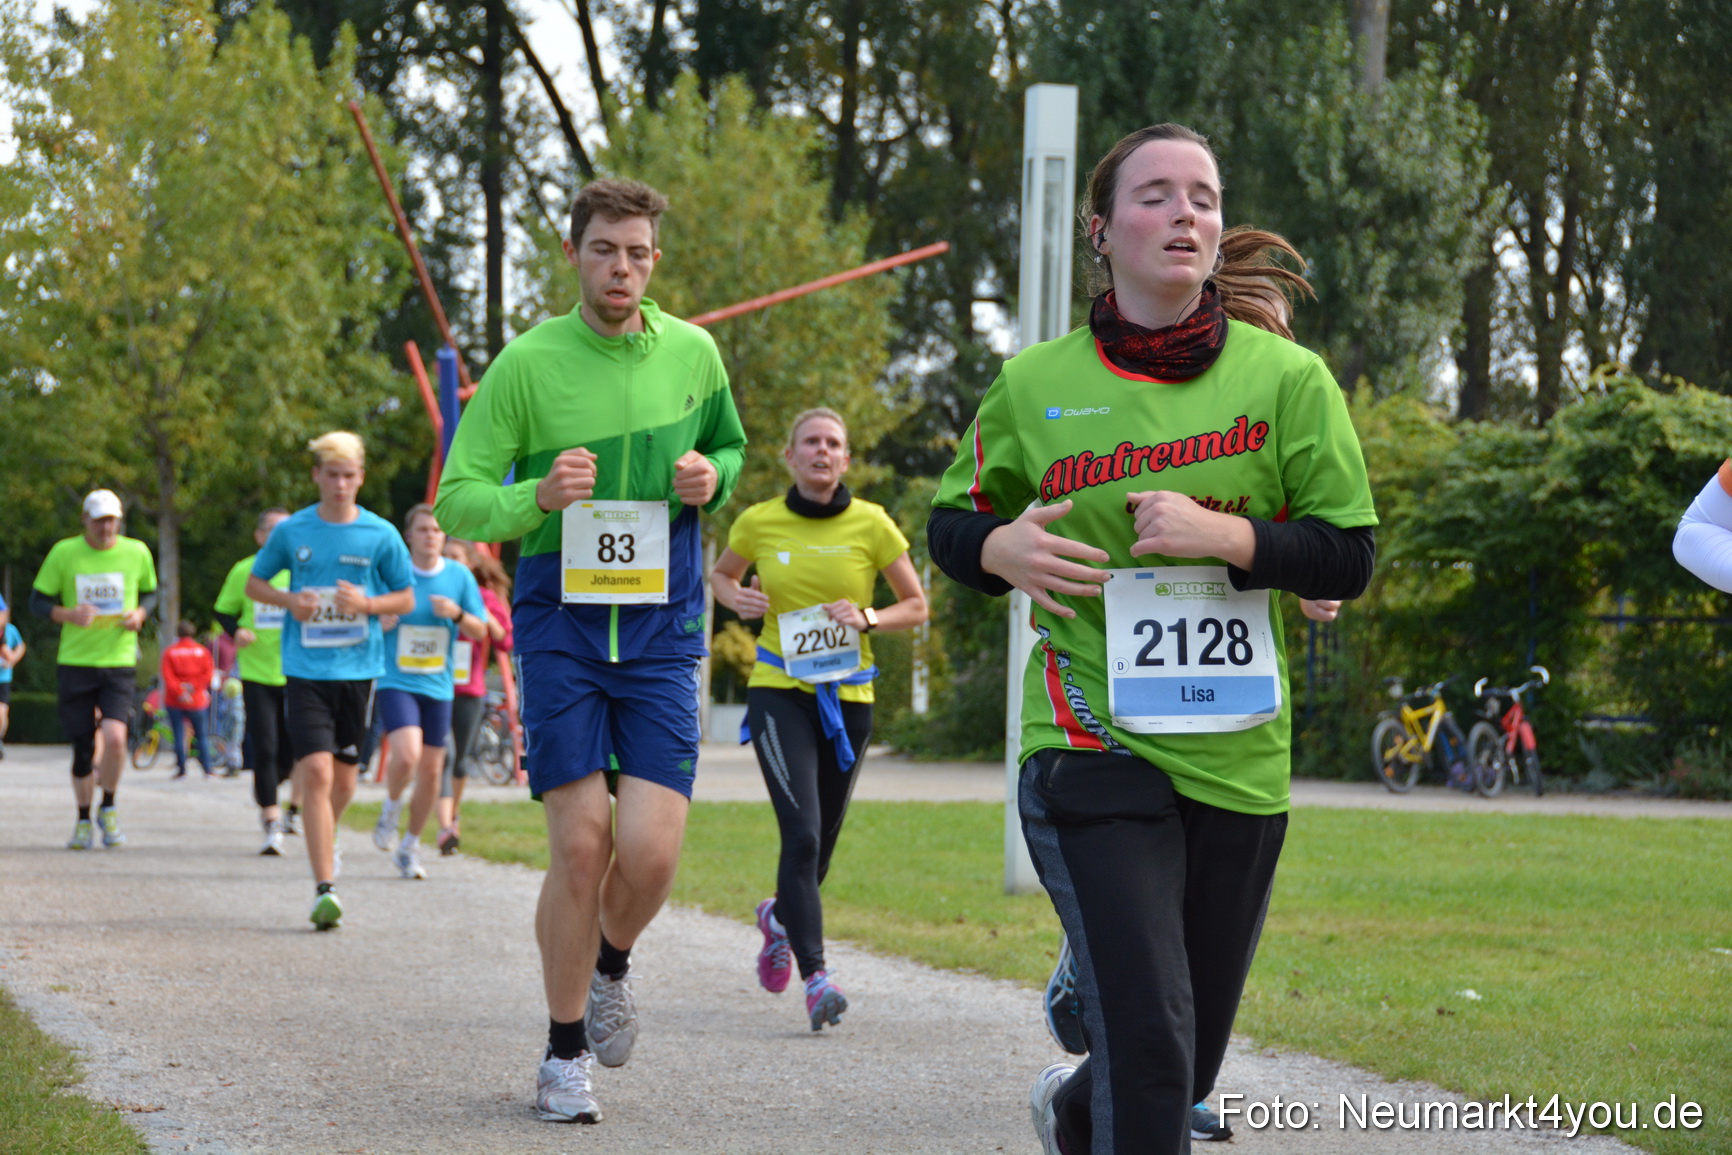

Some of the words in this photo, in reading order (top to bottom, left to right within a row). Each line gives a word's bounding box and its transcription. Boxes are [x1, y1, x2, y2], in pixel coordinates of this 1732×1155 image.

[1040, 414, 1269, 503] Alfafreunde
[597, 533, 635, 564] 83
[590, 574, 641, 586] Johannes
[1173, 582, 1227, 596] BOCK
[793, 624, 850, 655] 2202
[1133, 618, 1254, 667] 2128
[1117, 661, 1125, 671] D
[1181, 685, 1215, 703] Lisa
